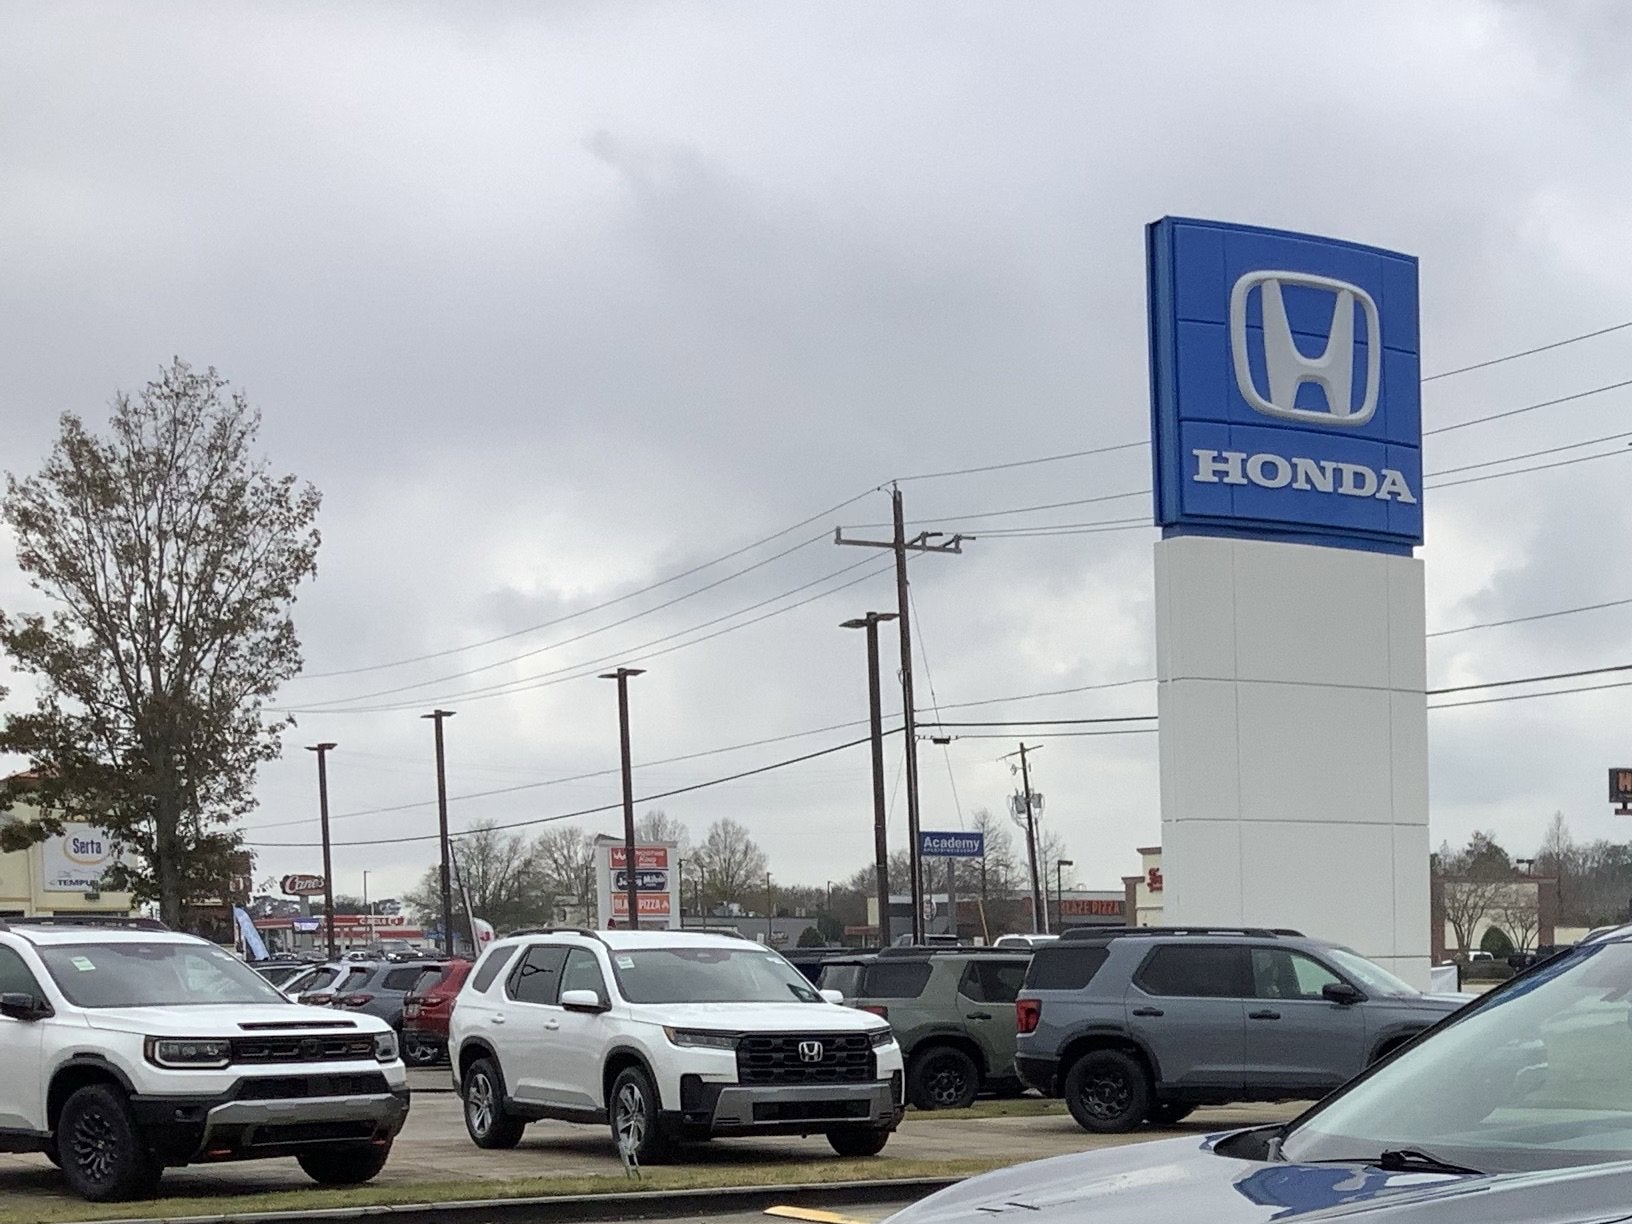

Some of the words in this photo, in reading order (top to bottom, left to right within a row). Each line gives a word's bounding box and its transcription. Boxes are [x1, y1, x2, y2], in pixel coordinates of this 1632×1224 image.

[1192, 448, 1417, 504] HONDA
[73, 838, 102, 854] Serta
[923, 836, 980, 852] Academy
[639, 899, 661, 910] PIZZA
[1092, 901, 1120, 914] PIZZA
